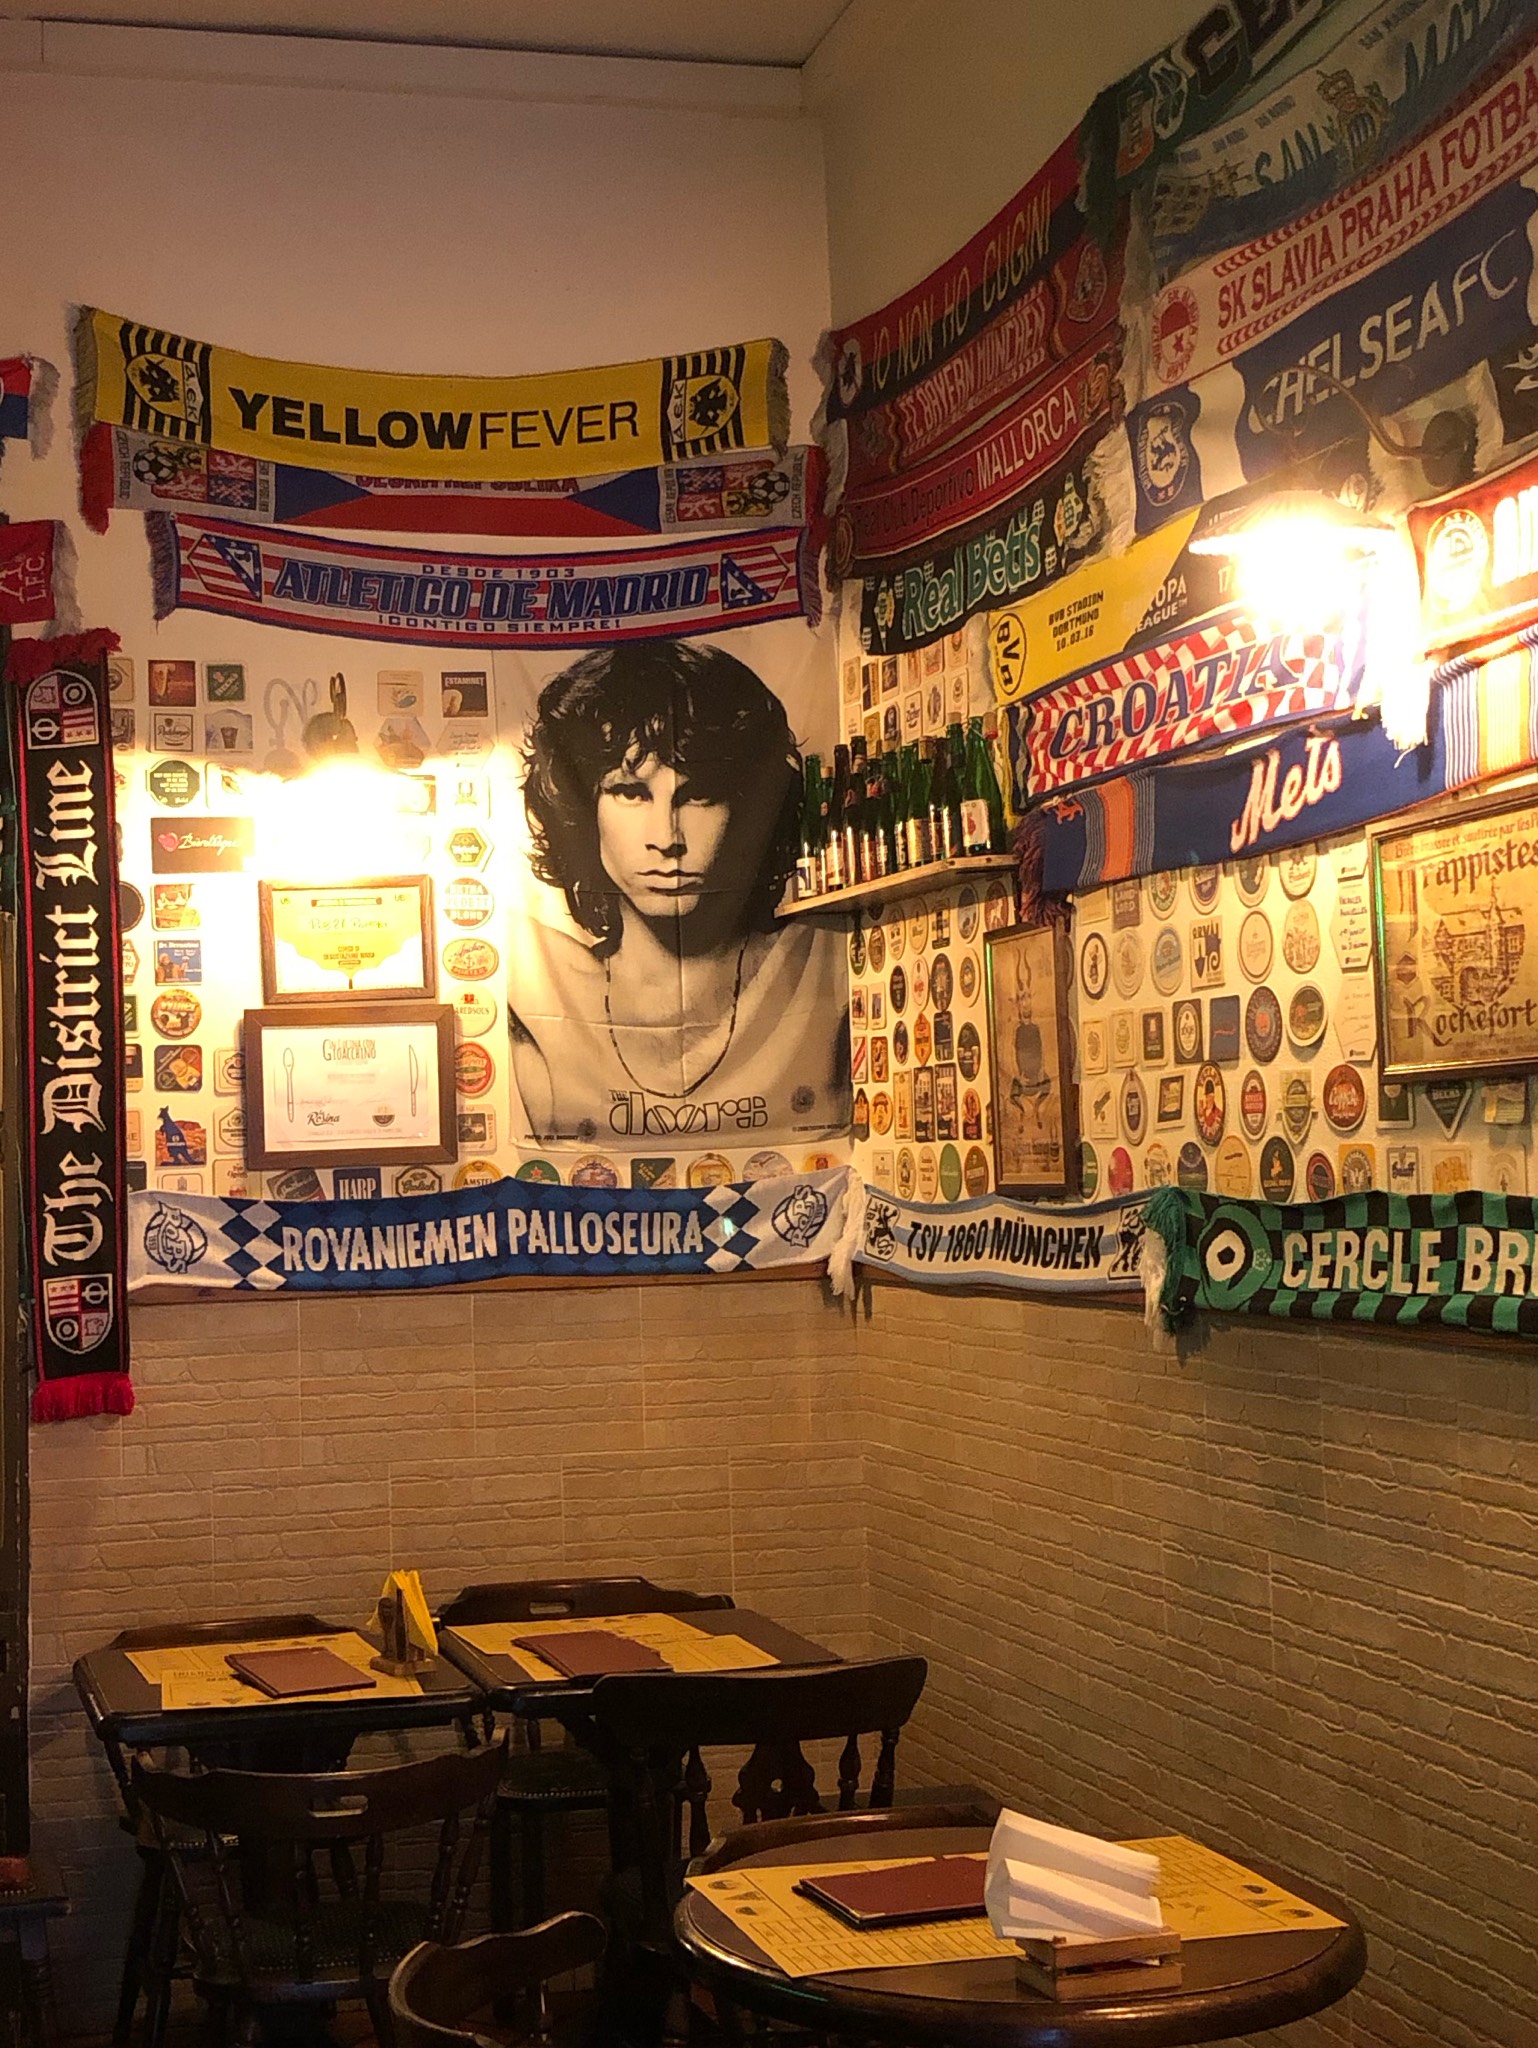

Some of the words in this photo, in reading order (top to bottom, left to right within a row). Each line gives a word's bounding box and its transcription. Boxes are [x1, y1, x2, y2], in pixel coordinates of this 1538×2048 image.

[1219, 279, 1247, 328] SK
[1252, 229, 1335, 311] SLAVIA
[1340, 152, 1439, 260] PRAHA
[897, 294, 934, 380] NON
[942, 267, 970, 347] HO
[982, 180, 1051, 311] CUGINI
[1248, 281, 1450, 432] CHELSEA
[1452, 229, 1519, 327] FC
[917, 348, 975, 425] BAYERN
[976, 386, 1078, 491] MALLORCA
[273, 558, 473, 619] ATLETICO
[480, 579, 546, 621] DE
[546, 564, 710, 620] MADRID
[422, 564, 502, 579] DESDE
[516, 568, 576, 579] 1903
[903, 546, 964, 640] Real
[1067, 590, 1104, 619] STADION
[1052, 608, 1100, 641] DORTMUND
[1050, 633, 1300, 760] CROATIA
[34, 759, 99, 890] Line
[1229, 736, 1342, 854] Mets
[40, 904, 107, 1135] District
[455, 1006, 490, 1016] AREDSOUS
[1403, 994, 1538, 1047] Rochefort
[608, 1089, 630, 1102] THE
[43, 1151, 113, 1266] The
[338, 1177, 377, 1200] HARP
[282, 1211, 498, 1273] ROVANIEMEN
[507, 1207, 704, 1256] PALLOSEURA
[907, 1221, 942, 1263] TSV
[944, 1219, 989, 1264] 1860
[989, 1216, 1105, 1270] MÜNCHEN
[1283, 1227, 1443, 1295] CERCLE
